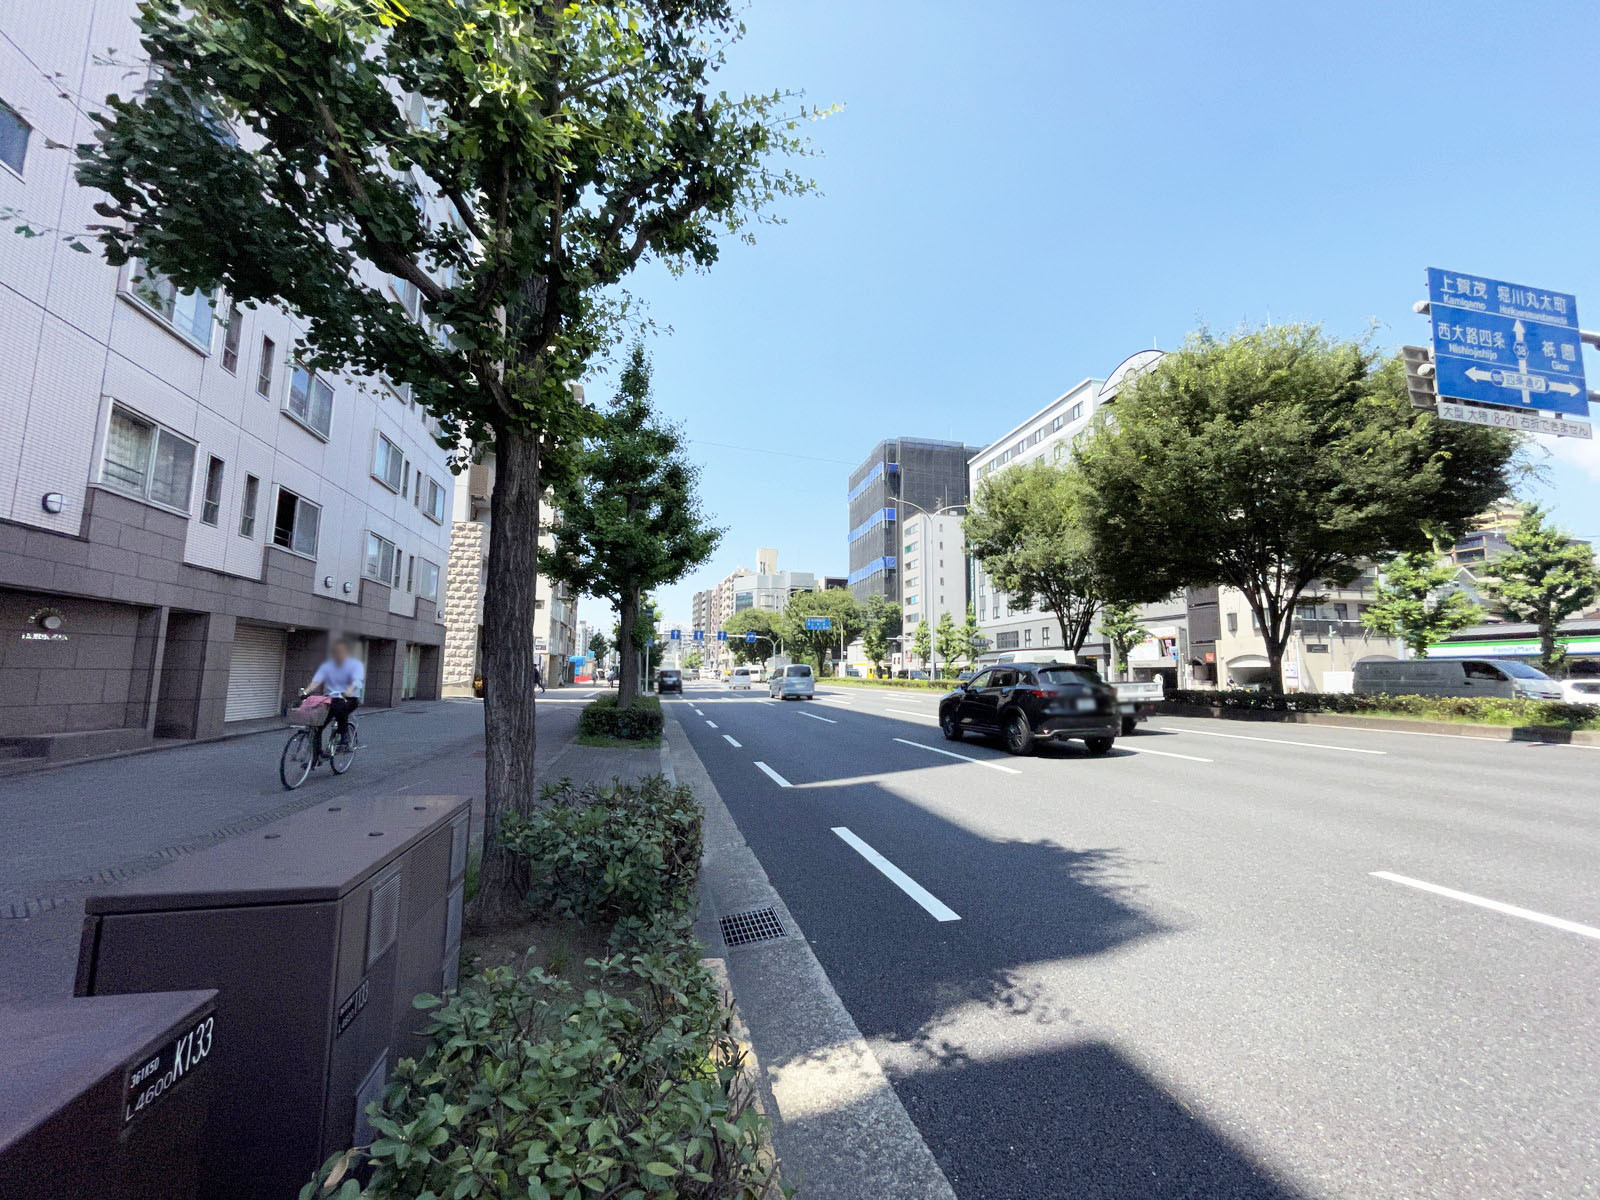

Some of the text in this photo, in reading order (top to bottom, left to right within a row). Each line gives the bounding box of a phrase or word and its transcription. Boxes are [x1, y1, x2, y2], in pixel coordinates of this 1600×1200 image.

[1440, 274, 1567, 314] 上賀茂 堀川丸太町
[1438, 322, 1506, 349] 西大路四条
[1443, 406, 1464, 420] 大型
[1520, 416, 1588, 436] 右折できません
[172, 1016, 214, 1081] K133
